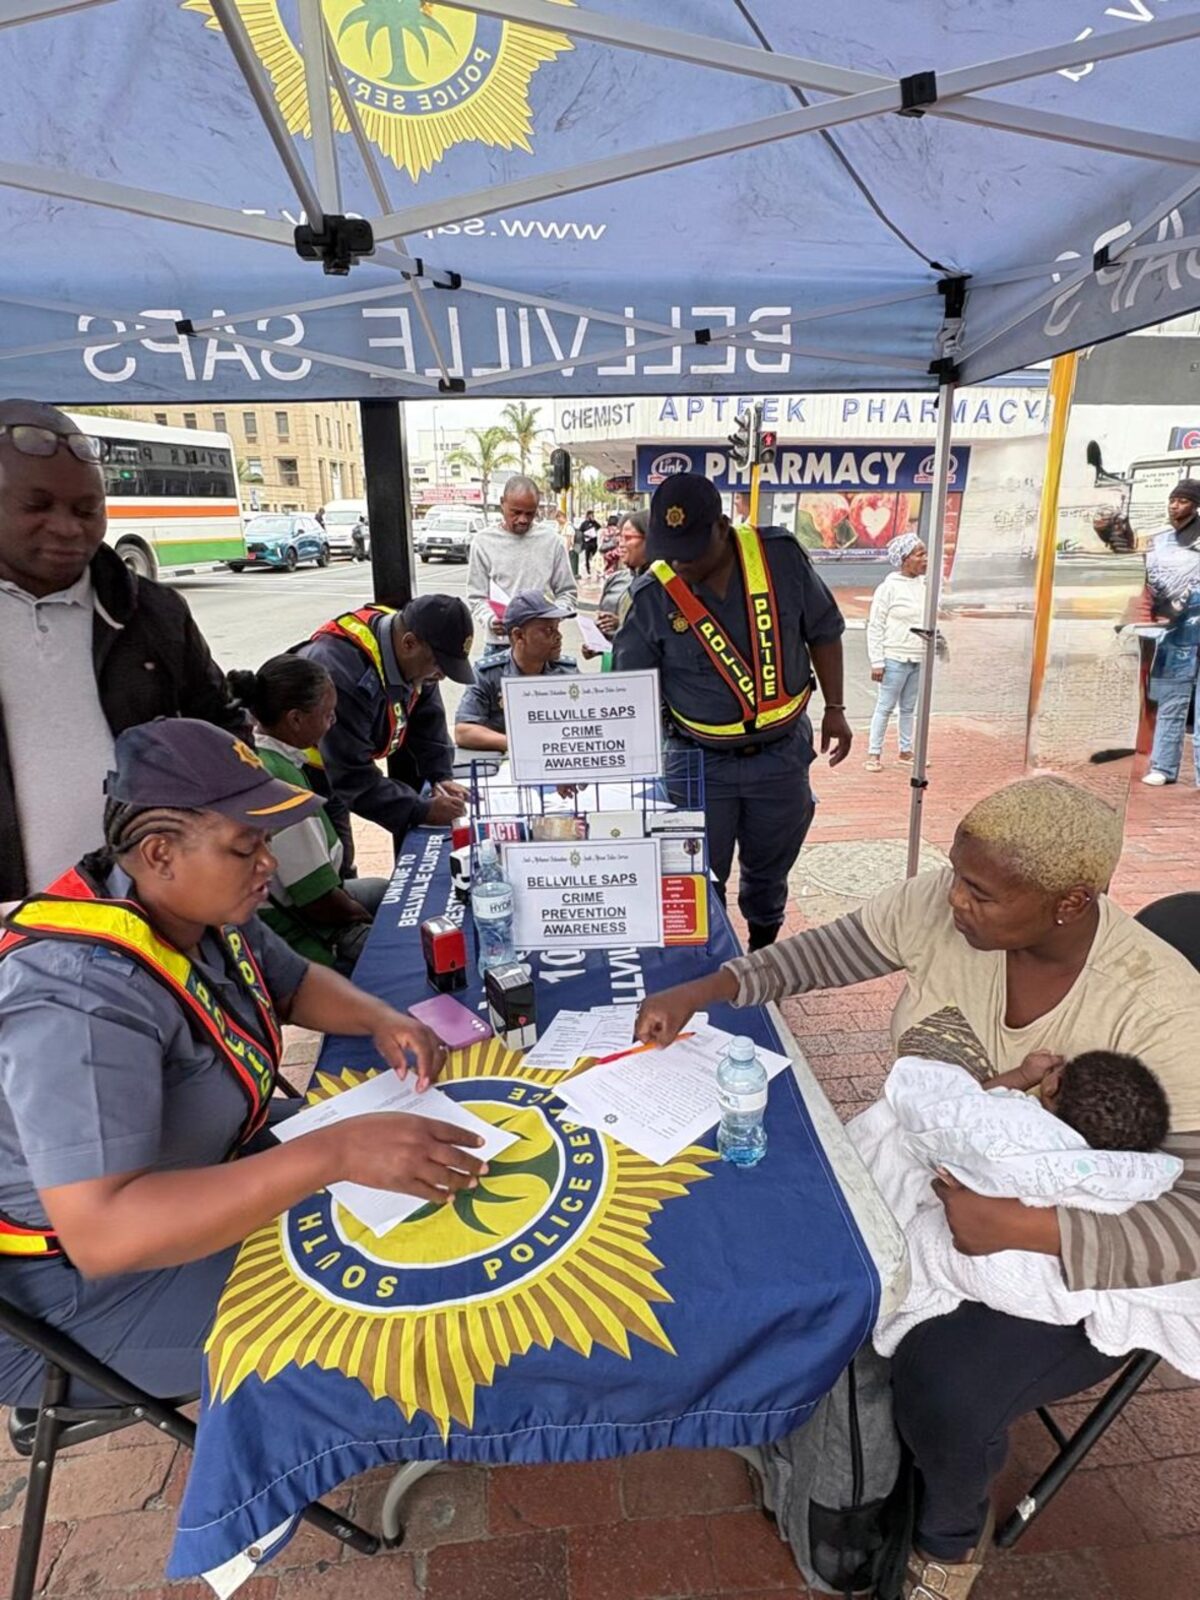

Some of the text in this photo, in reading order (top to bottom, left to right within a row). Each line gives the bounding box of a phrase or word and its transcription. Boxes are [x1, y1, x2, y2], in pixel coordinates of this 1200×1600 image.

[561, 403, 635, 430] CHEMIST
[842, 398, 1040, 424] PHARMACY
[705, 452, 905, 485] PHARMACY
[754, 598, 776, 696] POLICE
[527, 705, 636, 722] BELLVILLE SAPS
[561, 725, 603, 738] CRIME
[542, 739, 625, 753] PREVENTION
[544, 754, 626, 768] AWARENESS
[489, 822, 518, 841] ACT!
[418, 834, 445, 874] CLUSTER
[527, 873, 638, 888] BELLVILLE SAPS
[561, 891, 604, 904] CRIME
[541, 906, 626, 919] PREVENTION
[543, 921, 627, 935] AWARENESS
[196, 982, 272, 1097] POLIC
[482, 1177, 592, 1281] POLICE
[297, 1211, 398, 1298] SOUTH
